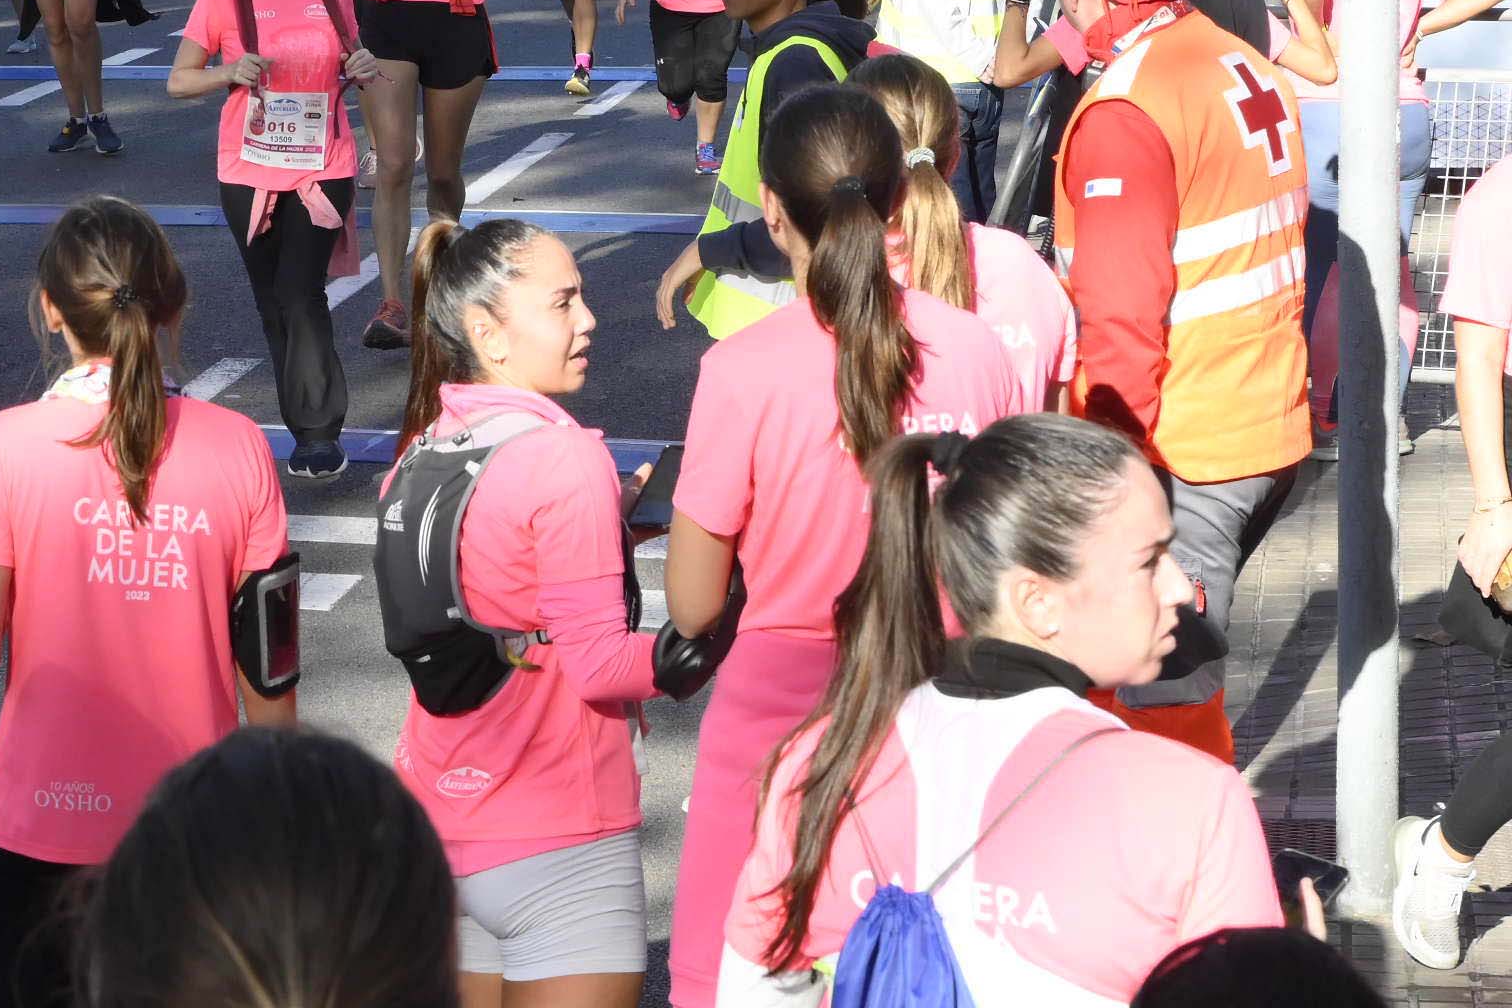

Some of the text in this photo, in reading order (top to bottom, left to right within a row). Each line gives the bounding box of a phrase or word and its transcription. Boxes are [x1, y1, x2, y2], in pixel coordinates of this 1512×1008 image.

[267, 121, 297, 133] 016
[73, 497, 213, 536] CARERA
[96, 528, 184, 561] DE LA
[87, 558, 189, 590] MUJER
[49, 779, 96, 793] 10 AÑOS
[34, 790, 113, 814] OYSHO
